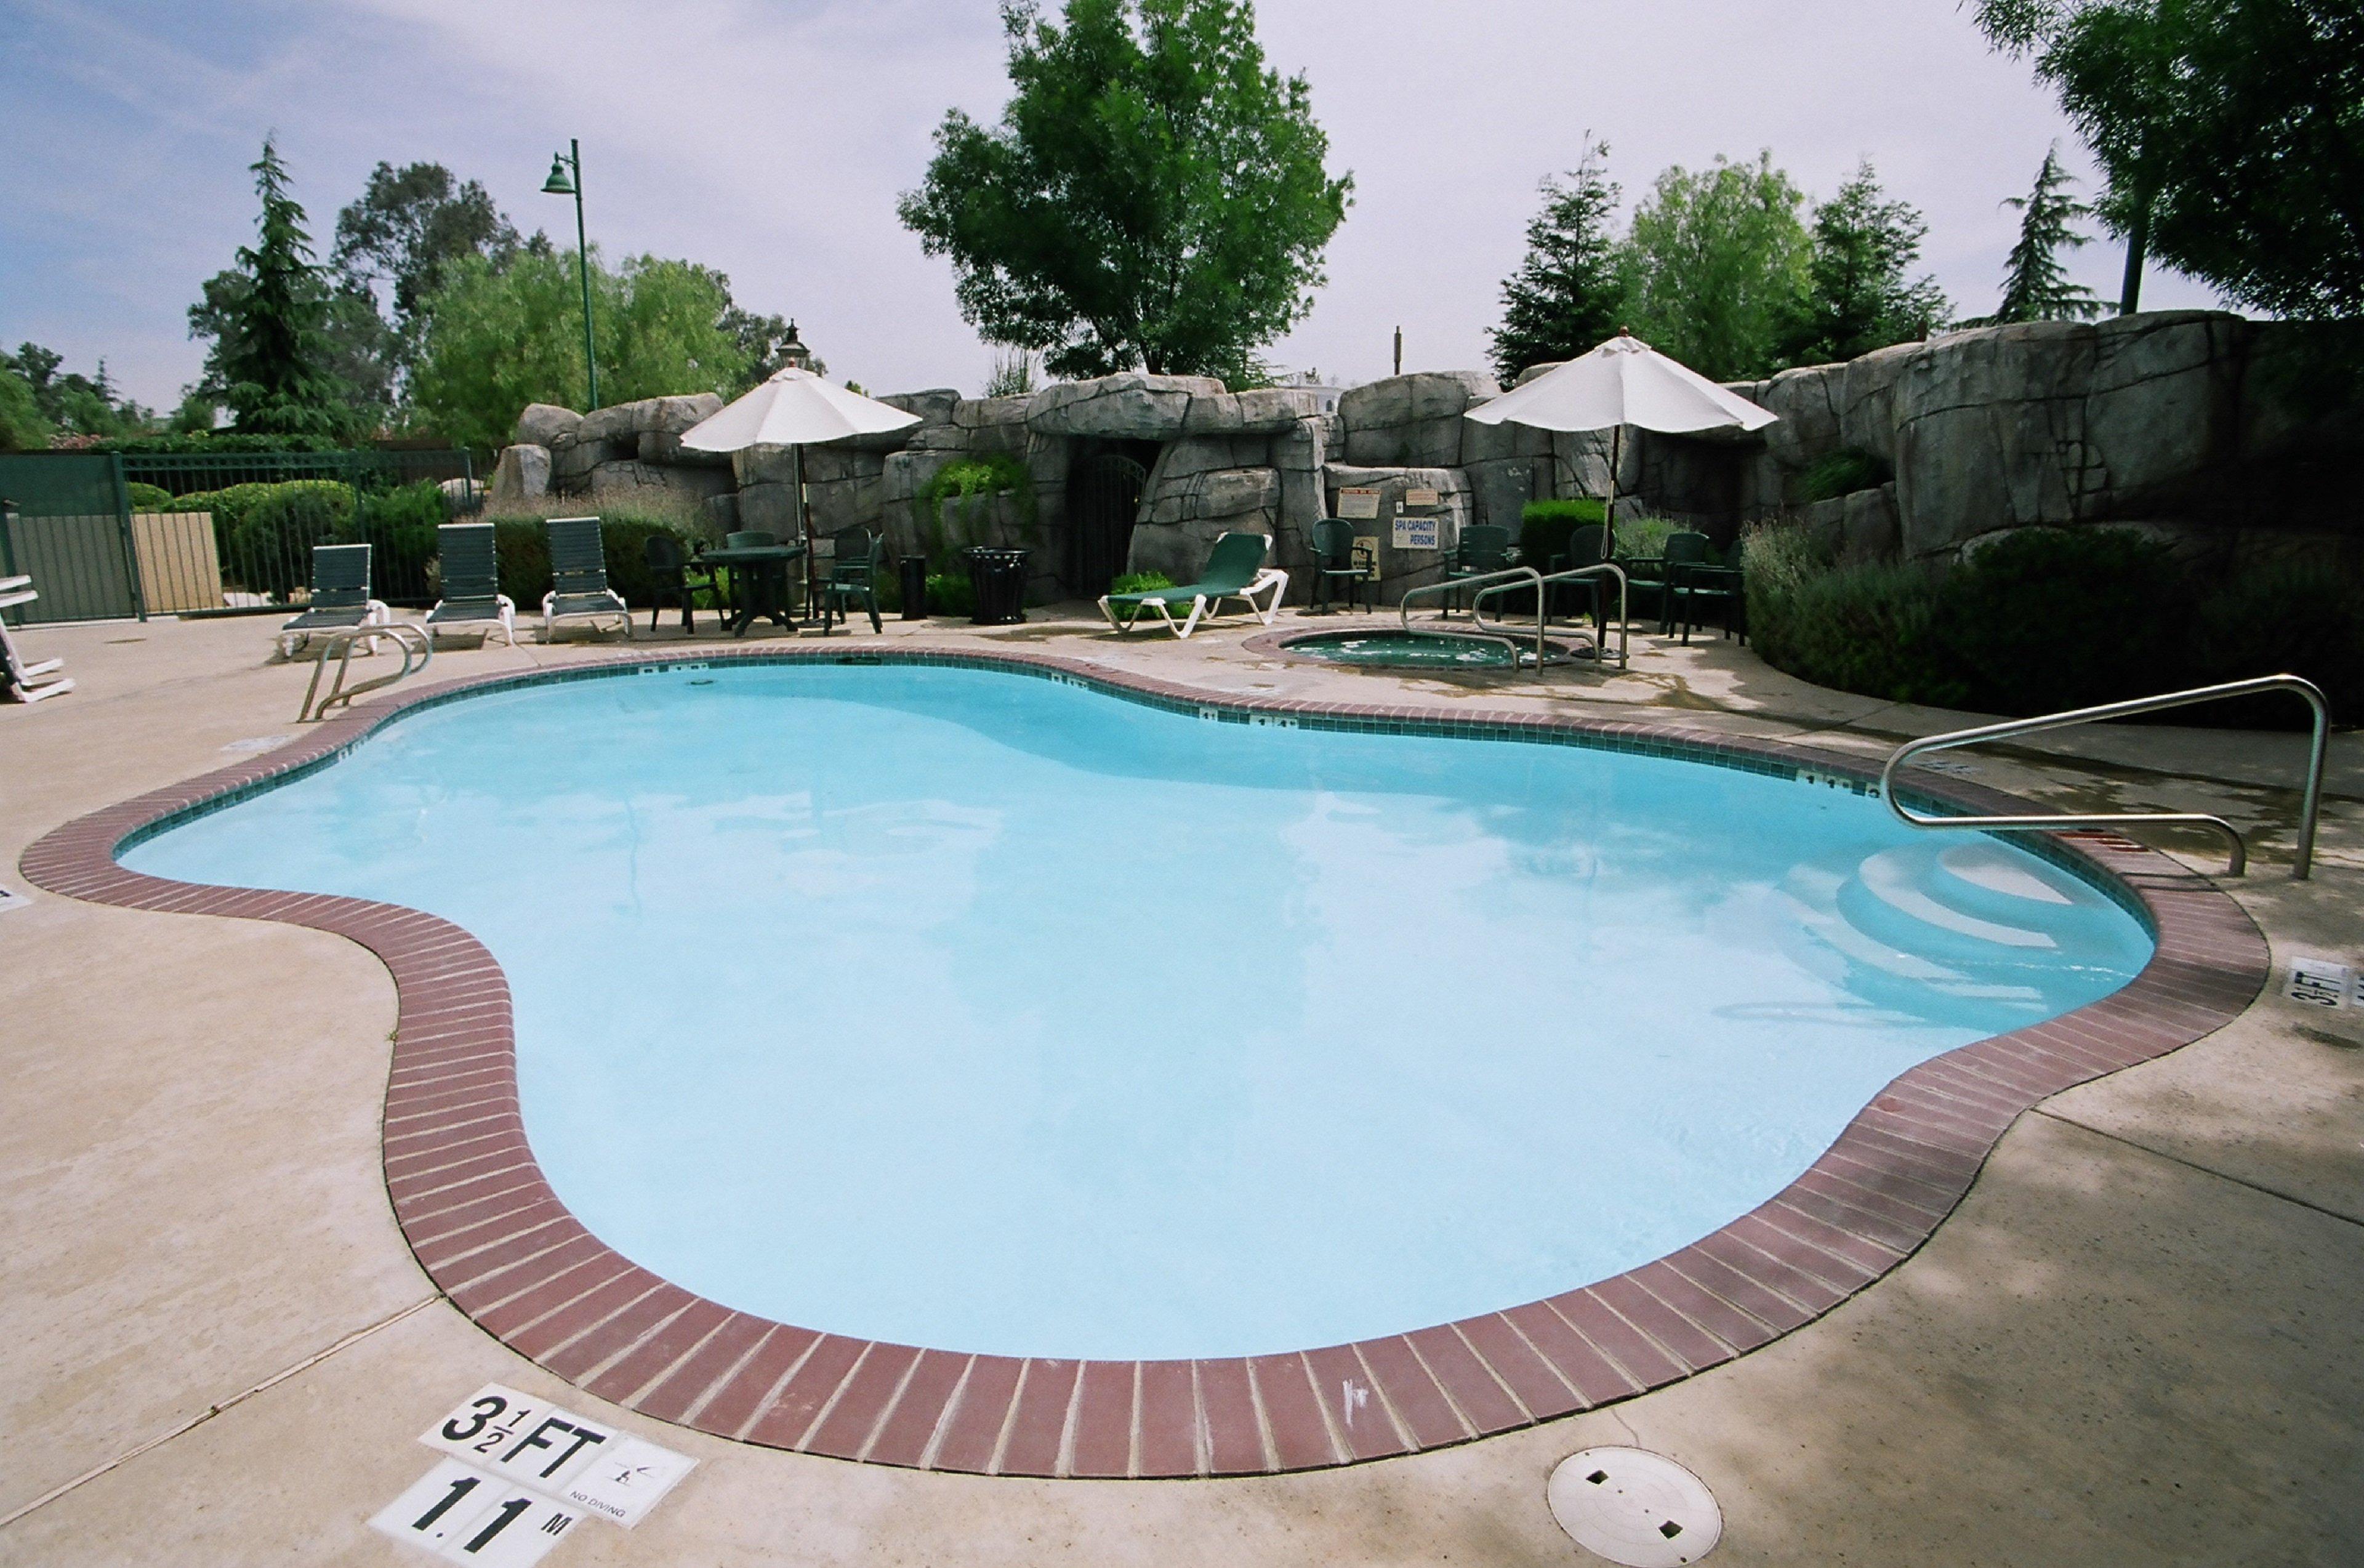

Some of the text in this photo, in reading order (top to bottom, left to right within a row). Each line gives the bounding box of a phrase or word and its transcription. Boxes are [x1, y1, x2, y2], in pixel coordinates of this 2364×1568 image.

[1395, 520, 1436, 531] SPA CAPACITY
[1410, 534, 1436, 545] PERSONS
[2294, 971, 2341, 992] FT
[500, 1417, 606, 1479] FT
[569, 1490, 626, 1518] NO DIVING
[541, 1513, 573, 1536] M
